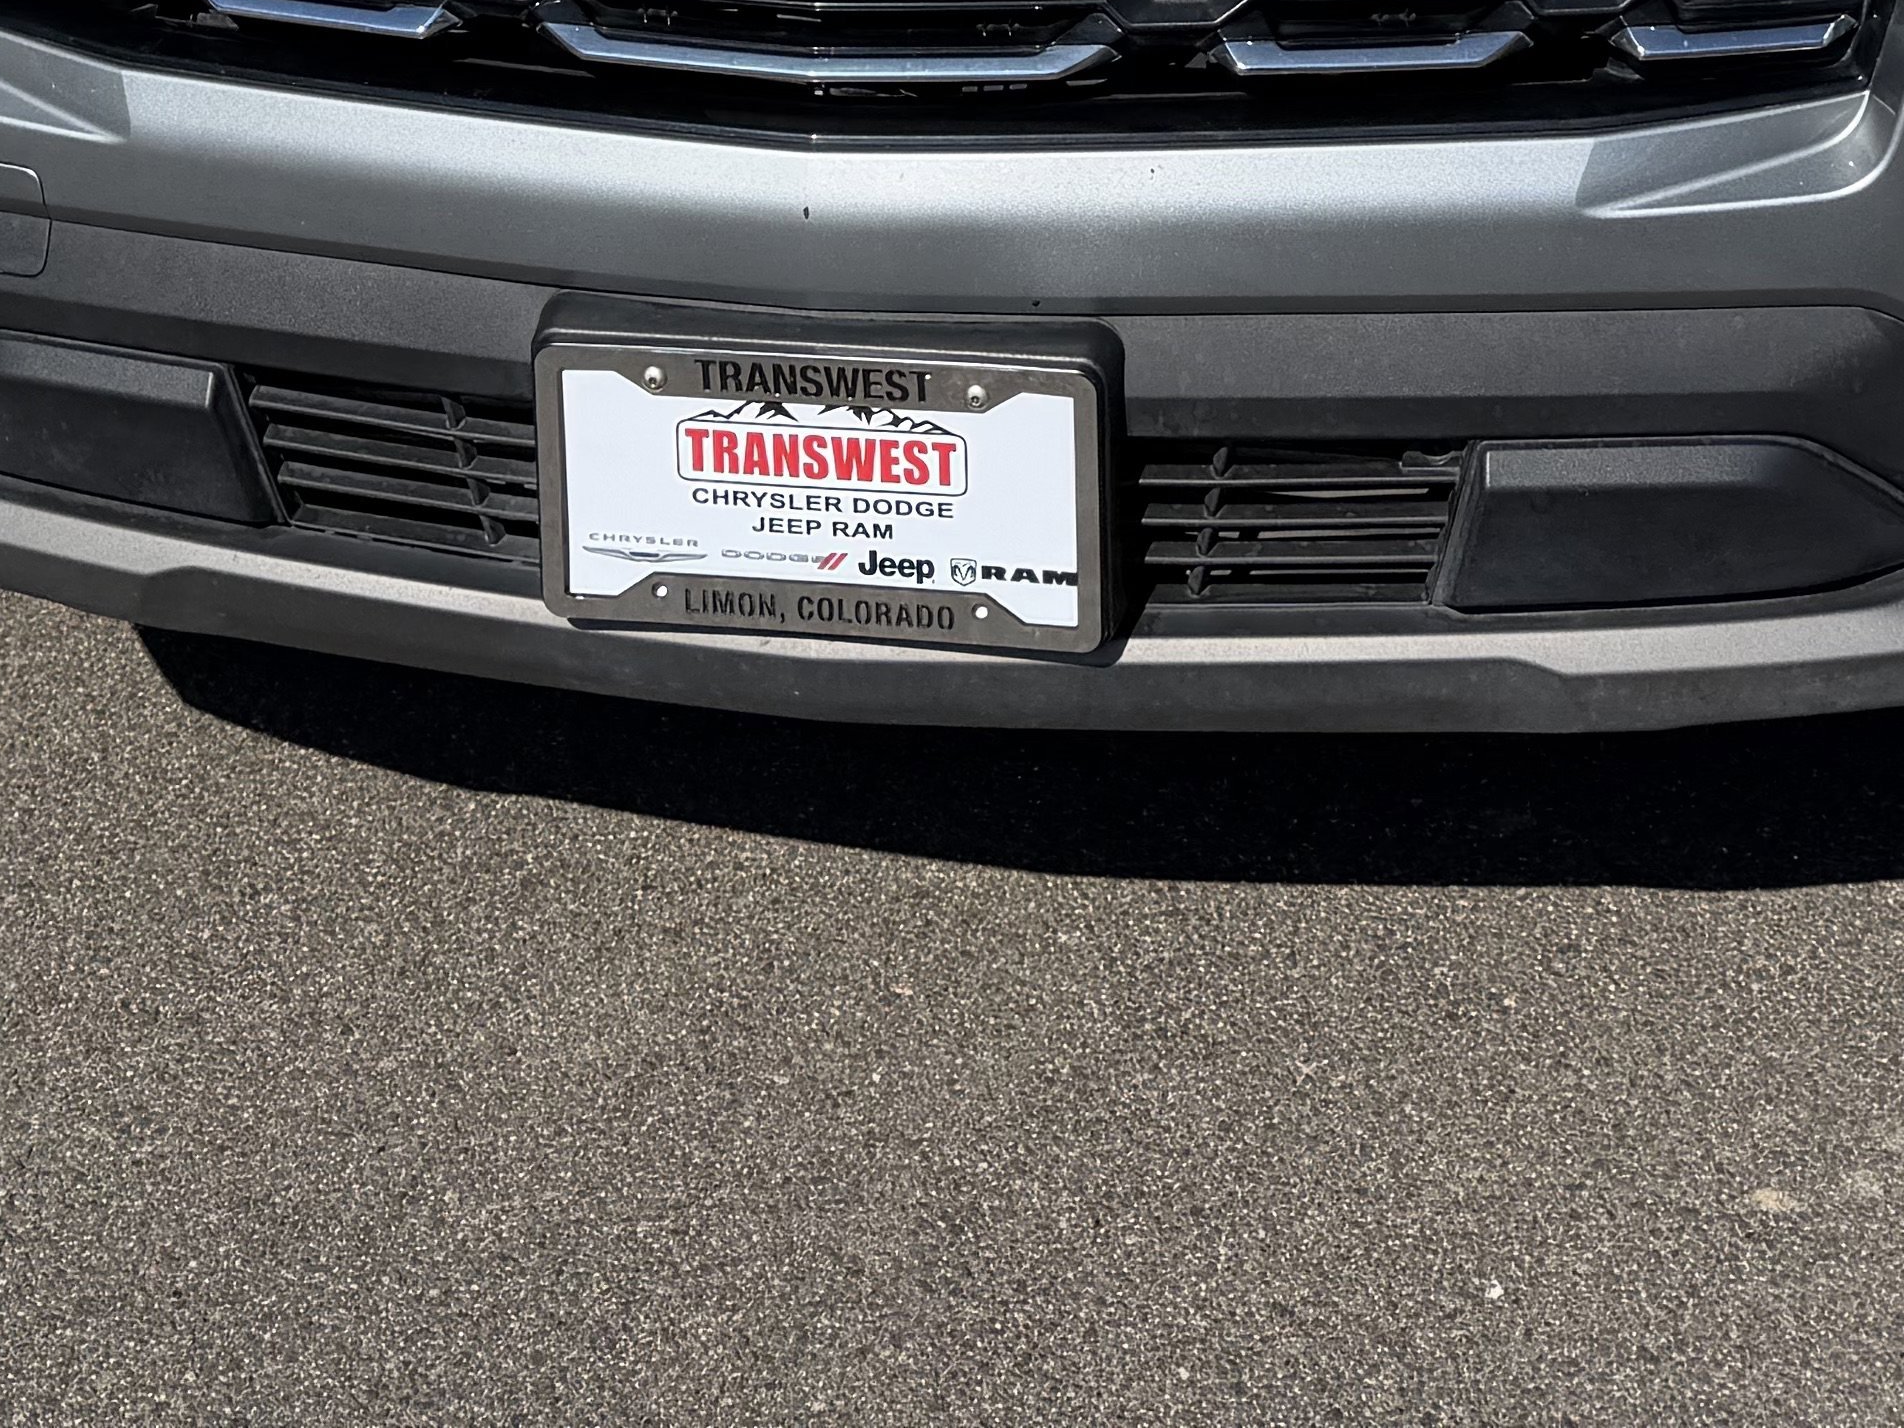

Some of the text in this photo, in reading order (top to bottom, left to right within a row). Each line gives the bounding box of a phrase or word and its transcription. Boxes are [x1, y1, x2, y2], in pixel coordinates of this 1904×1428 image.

[694, 359, 932, 403] TRANSWEST
[684, 428, 957, 487] TRANSWEST
[692, 488, 954, 519] CHRYSLER DODGE
[589, 532, 699, 548] CHRYSLER
[752, 517, 893, 539] JEEP RAM
[858, 550, 935, 584] Jeep
[981, 565, 1079, 587] RAM
[684, 588, 955, 630] LIMON, COLORADO
